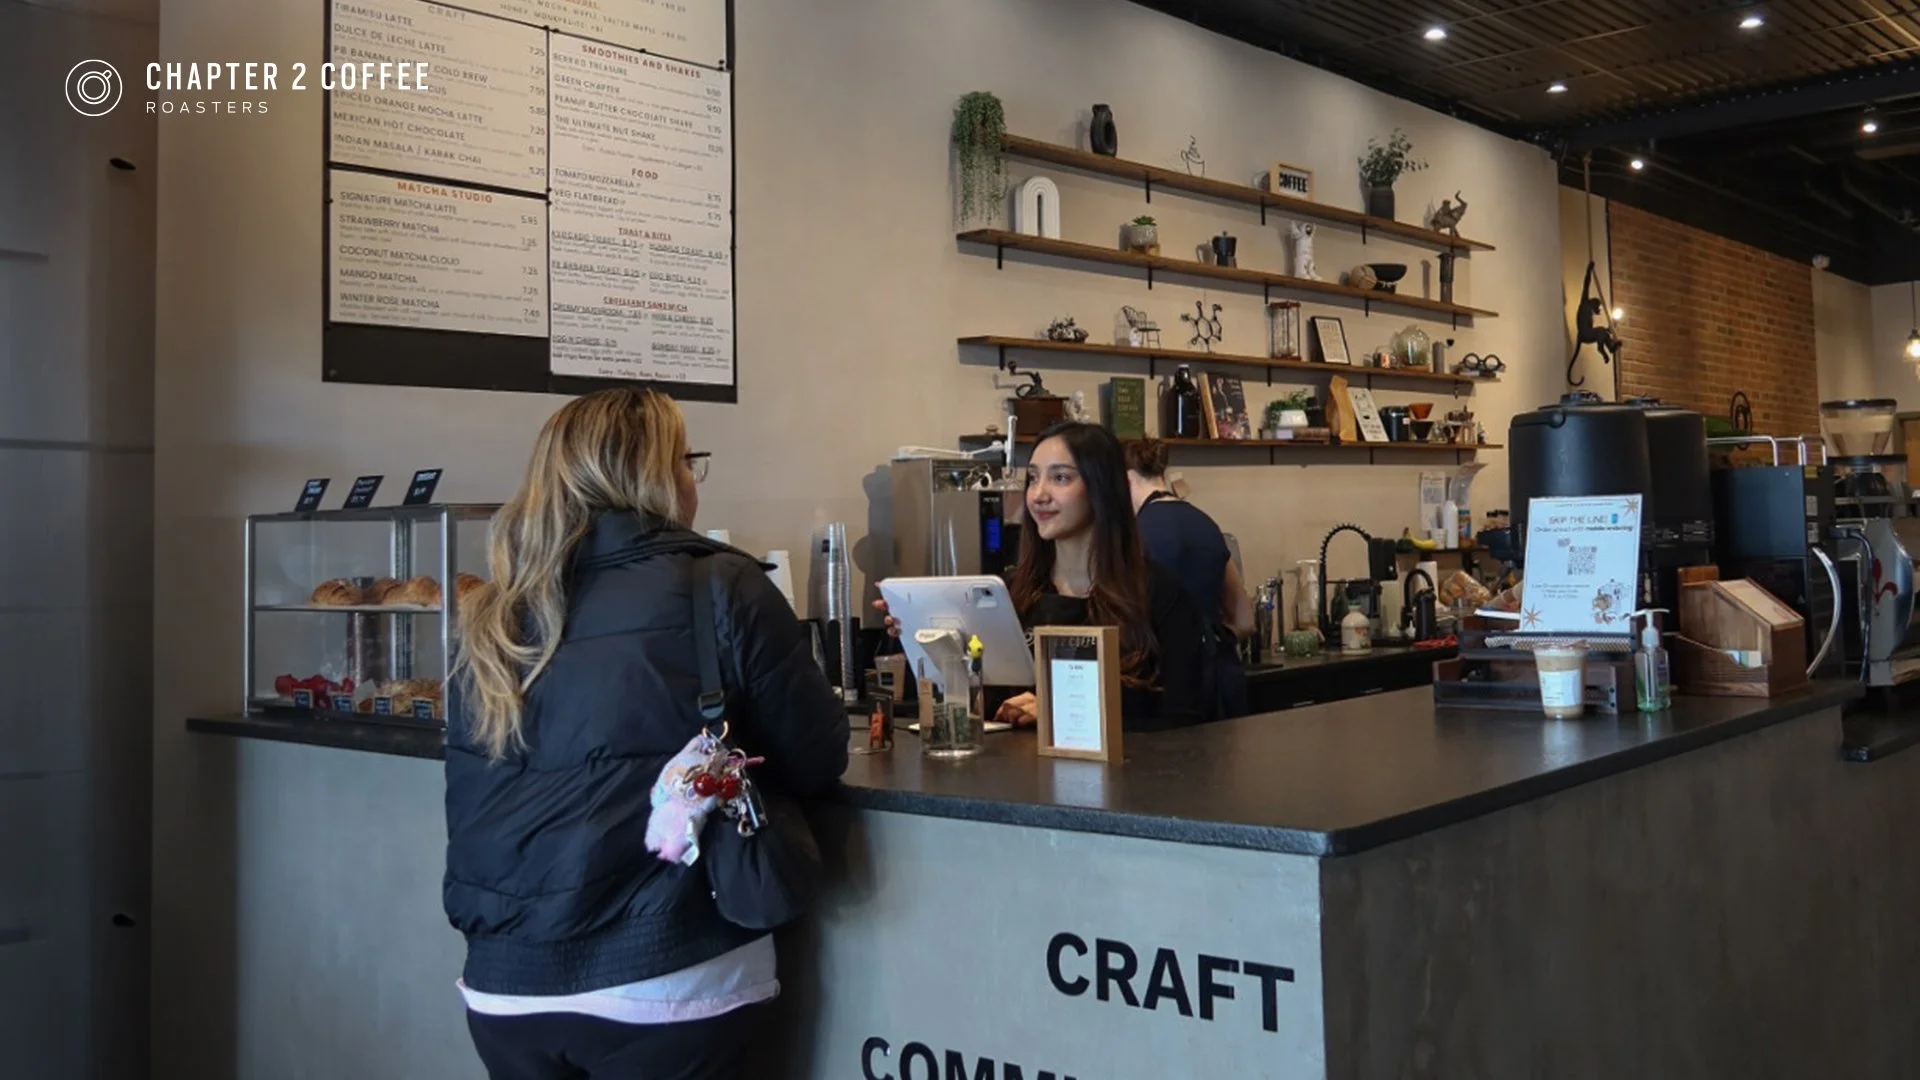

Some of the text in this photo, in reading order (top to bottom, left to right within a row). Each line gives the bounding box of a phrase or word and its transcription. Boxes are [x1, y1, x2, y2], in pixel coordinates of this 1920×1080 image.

[334, 2, 383, 19] TIRAMISU
[384, 13, 414, 26] LATTE
[333, 22, 367, 36] DULCE
[370, 30, 383, 40] DE
[387, 34, 416, 48] LECHE
[419, 40, 447, 54] LATTE
[350, 47, 393, 63] BANANA
[433, 64, 460, 78] COLD
[462, 70, 489, 83] BREW
[581, 43, 701, 79] SMOOTHIES AND SHAKES
[554, 73, 582, 86] GREEN
[583, 80, 620, 94] CHAPTER
[333, 89, 372, 103] SPICED
[374, 96, 416, 112] ORANGE
[417, 104, 455, 118] MOCHA
[456, 112, 483, 124] LATTE
[554, 94, 587, 107] PEANUT
[588, 101, 618, 113] BUTTER
[619, 107, 668, 124] CHOCOLATE
[333, 111, 381, 126] MEXICAN
[383, 120, 405, 130] HOT
[406, 123, 465, 141] CHOCOLATE
[554, 114, 570, 125] THE
[572, 119, 611, 133] ULTIMATE
[612, 125, 630, 136] NUT
[631, 128, 657, 142] SHAKE
[335, 133, 371, 146] INDIAN
[373, 139, 414, 153] MASALA
[457, 153, 483, 165] CHAI
[554, 167, 589, 181] TOMATO
[588, 174, 635, 189] MOZZARELLA
[631, 168, 659, 180] FOOD
[1278, 171, 1309, 194] COFFEE
[339, 190, 392, 205] SIGNATURE
[394, 198, 433, 211] MATCHA
[434, 202, 458, 215] LATTE
[396, 181, 494, 204] MATCHA STUDIO
[554, 188, 573, 199] VEG
[573, 191, 620, 205] FLATBREAD
[339, 213, 400, 229] STRAWBERRY
[402, 221, 440, 234] MATCHA
[619, 227, 643, 237] TOAST
[338, 243, 389, 258] COCONUT
[390, 250, 428, 262] MATCHA
[429, 255, 460, 266] CLOUD
[339, 267, 378, 280] MANGO
[379, 271, 418, 284] MATCHA
[339, 291, 375, 303] WINTER
[376, 294, 400, 306] ROSE
[401, 297, 441, 309] MATCHA
[647, 300, 689, 312] SANDWICH
[1549, 515, 1567, 524] SKIP
[1570, 515, 1585, 524] THE
[1046, 931, 1295, 1033] CRAFT
